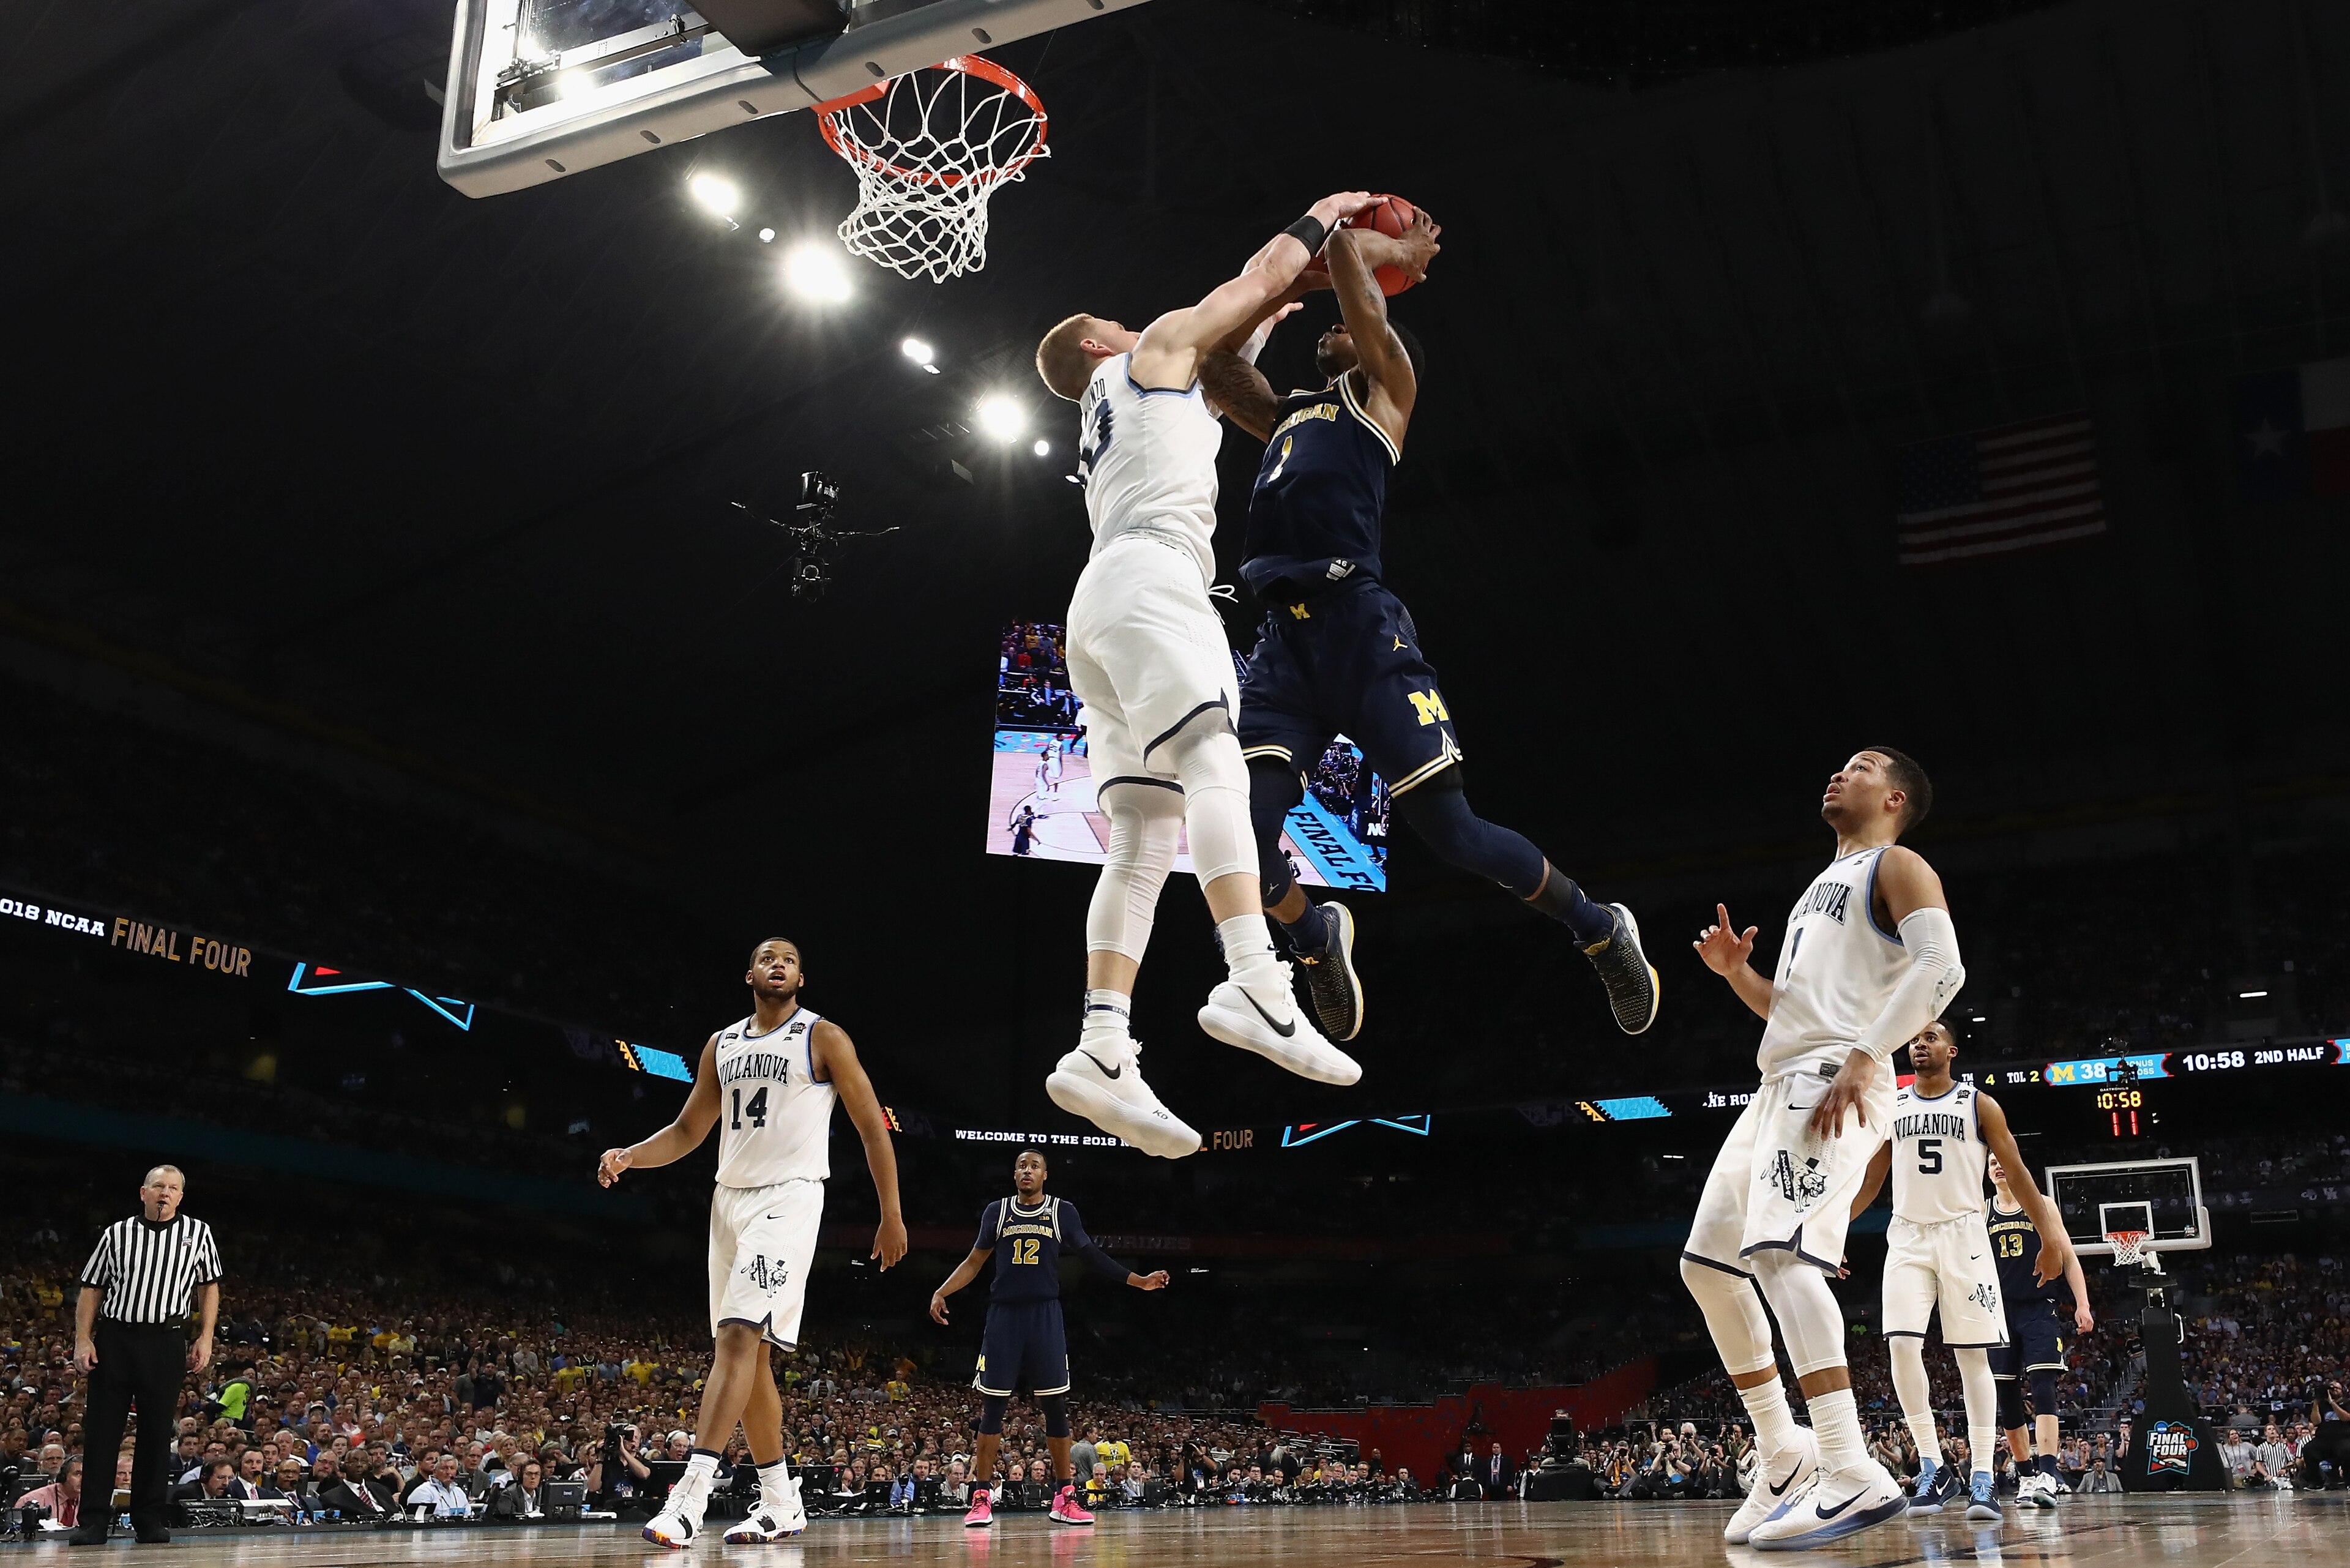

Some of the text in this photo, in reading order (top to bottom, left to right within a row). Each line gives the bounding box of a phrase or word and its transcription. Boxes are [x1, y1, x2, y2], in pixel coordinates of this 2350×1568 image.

[1407, 688, 1449, 726] M
[1288, 812, 1356, 867] FINAL
[0, 898, 252, 978] 018 NCAA FINAL FOUR
[720, 1053, 790, 1086] VILLANOVA
[2183, 1047, 2324, 1071] 10:58 2ND HALF
[1985, 1074, 1995, 1085] 4
[2007, 1072, 2026, 1083] TOL
[2029, 1070, 2040, 1082] 2
[2051, 1064, 2075, 1083] M
[2081, 1062, 2106, 1079] 38
[731, 1087, 767, 1130] 14
[2097, 1091, 2141, 1109] 10:58
[955, 1130, 1025, 1142] WELCOME
[1029, 1134, 1047, 1143] TO
[1051, 1135, 1079, 1144] THE
[1083, 1136, 1116, 1146] 2018
[1213, 1129, 1254, 1151] FOUR
[1894, 1113, 1966, 1143] VILLANOVA
[1918, 1139, 1942, 1174] 5
[1002, 1223, 1053, 1239] MICHIGAN
[1012, 1238, 1040, 1264] 12
[1999, 1233, 2023, 1258] 13
[2149, 1432, 2185, 1446] FINAL
[2153, 1444, 2188, 1457] FOUR
